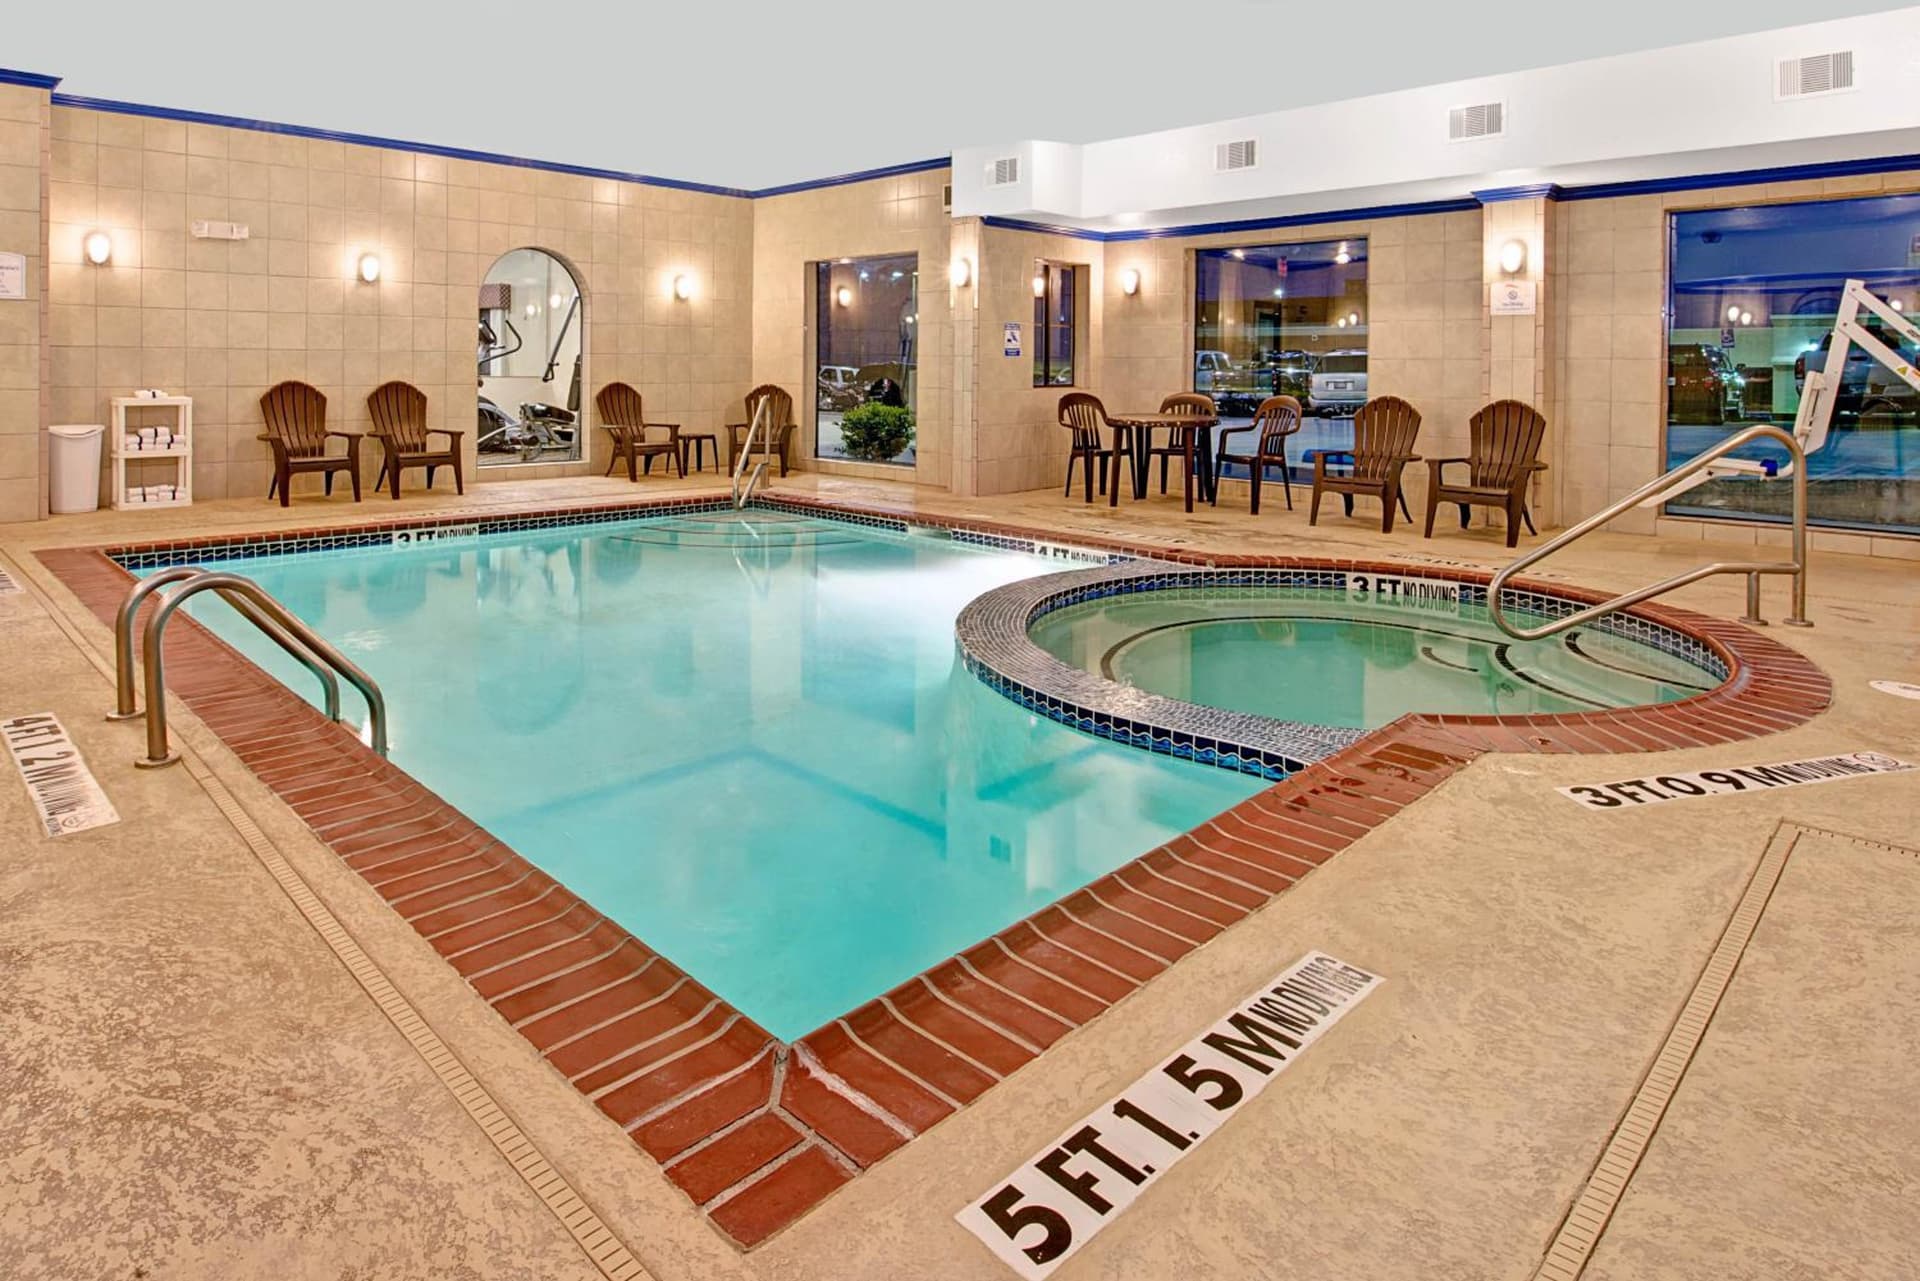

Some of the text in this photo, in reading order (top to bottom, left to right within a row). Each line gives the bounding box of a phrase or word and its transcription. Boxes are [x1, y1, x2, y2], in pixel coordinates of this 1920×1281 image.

[1403, 581, 1416, 600] NO
[1418, 583, 1457, 604] DIVING
[1570, 787, 1622, 807] 3
[1247, 997, 1318, 1036] NO
[1201, 1012, 1302, 1076] M
[980, 1184, 1072, 1265] 5
